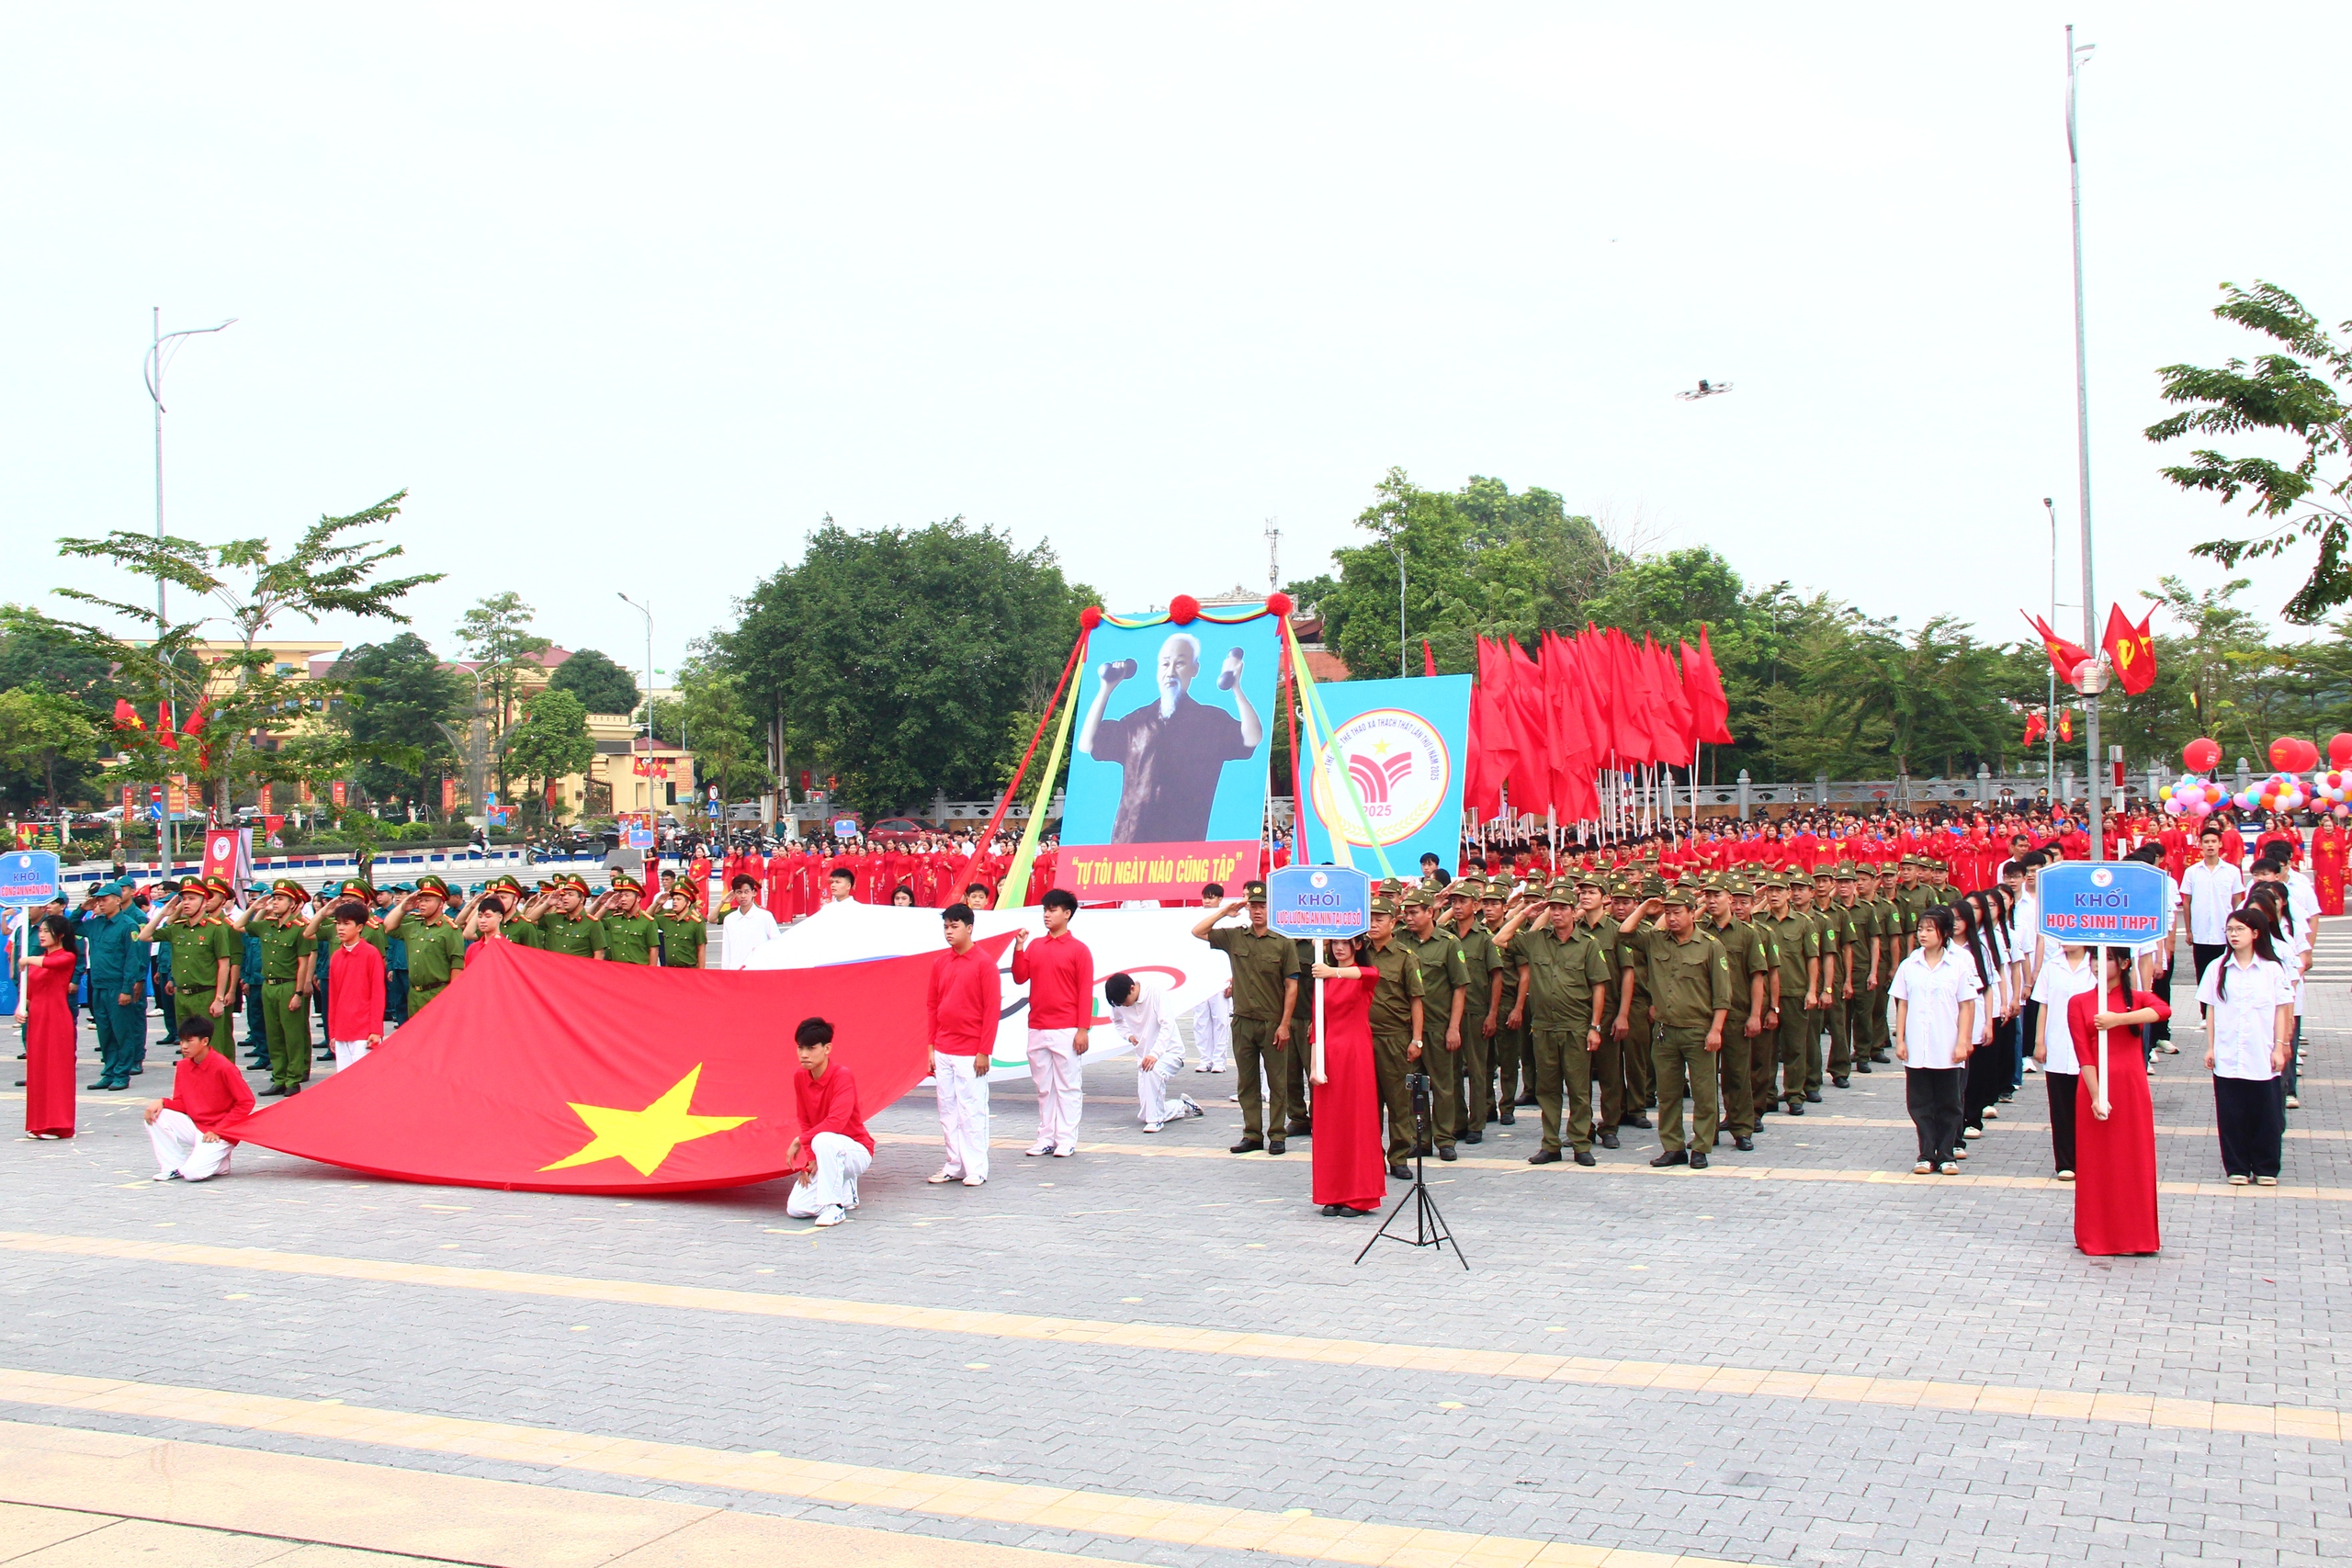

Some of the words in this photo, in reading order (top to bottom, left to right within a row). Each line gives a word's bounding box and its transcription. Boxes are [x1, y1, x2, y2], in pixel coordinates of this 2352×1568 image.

[1351, 723, 1367, 737] THAO
[1377, 718, 1397, 728] THẠCH
[1430, 765, 1440, 781] 2025
[13, 868, 40, 882] KHỐI
[1093, 857, 1113, 885] TÔI
[1114, 856, 1147, 885] NGÀY
[1148, 855, 1174, 884] NÀO
[1176, 854, 1210, 883] CŨNG
[1297, 888, 1340, 906] KHỐI
[2075, 887, 2129, 908] KHỐI
[1276, 909, 1289, 927] LỰC
[1289, 909, 1310, 928] LƯỢNG
[1310, 911, 1319, 925] AN
[1332, 911, 1342, 928] TẠI
[1343, 910, 1351, 926] CƠ
[1352, 908, 1362, 926] SỞ
[2046, 914, 2075, 931] HỌC
[2080, 914, 2116, 929] SINH
[2120, 916, 2158, 931] THPT
